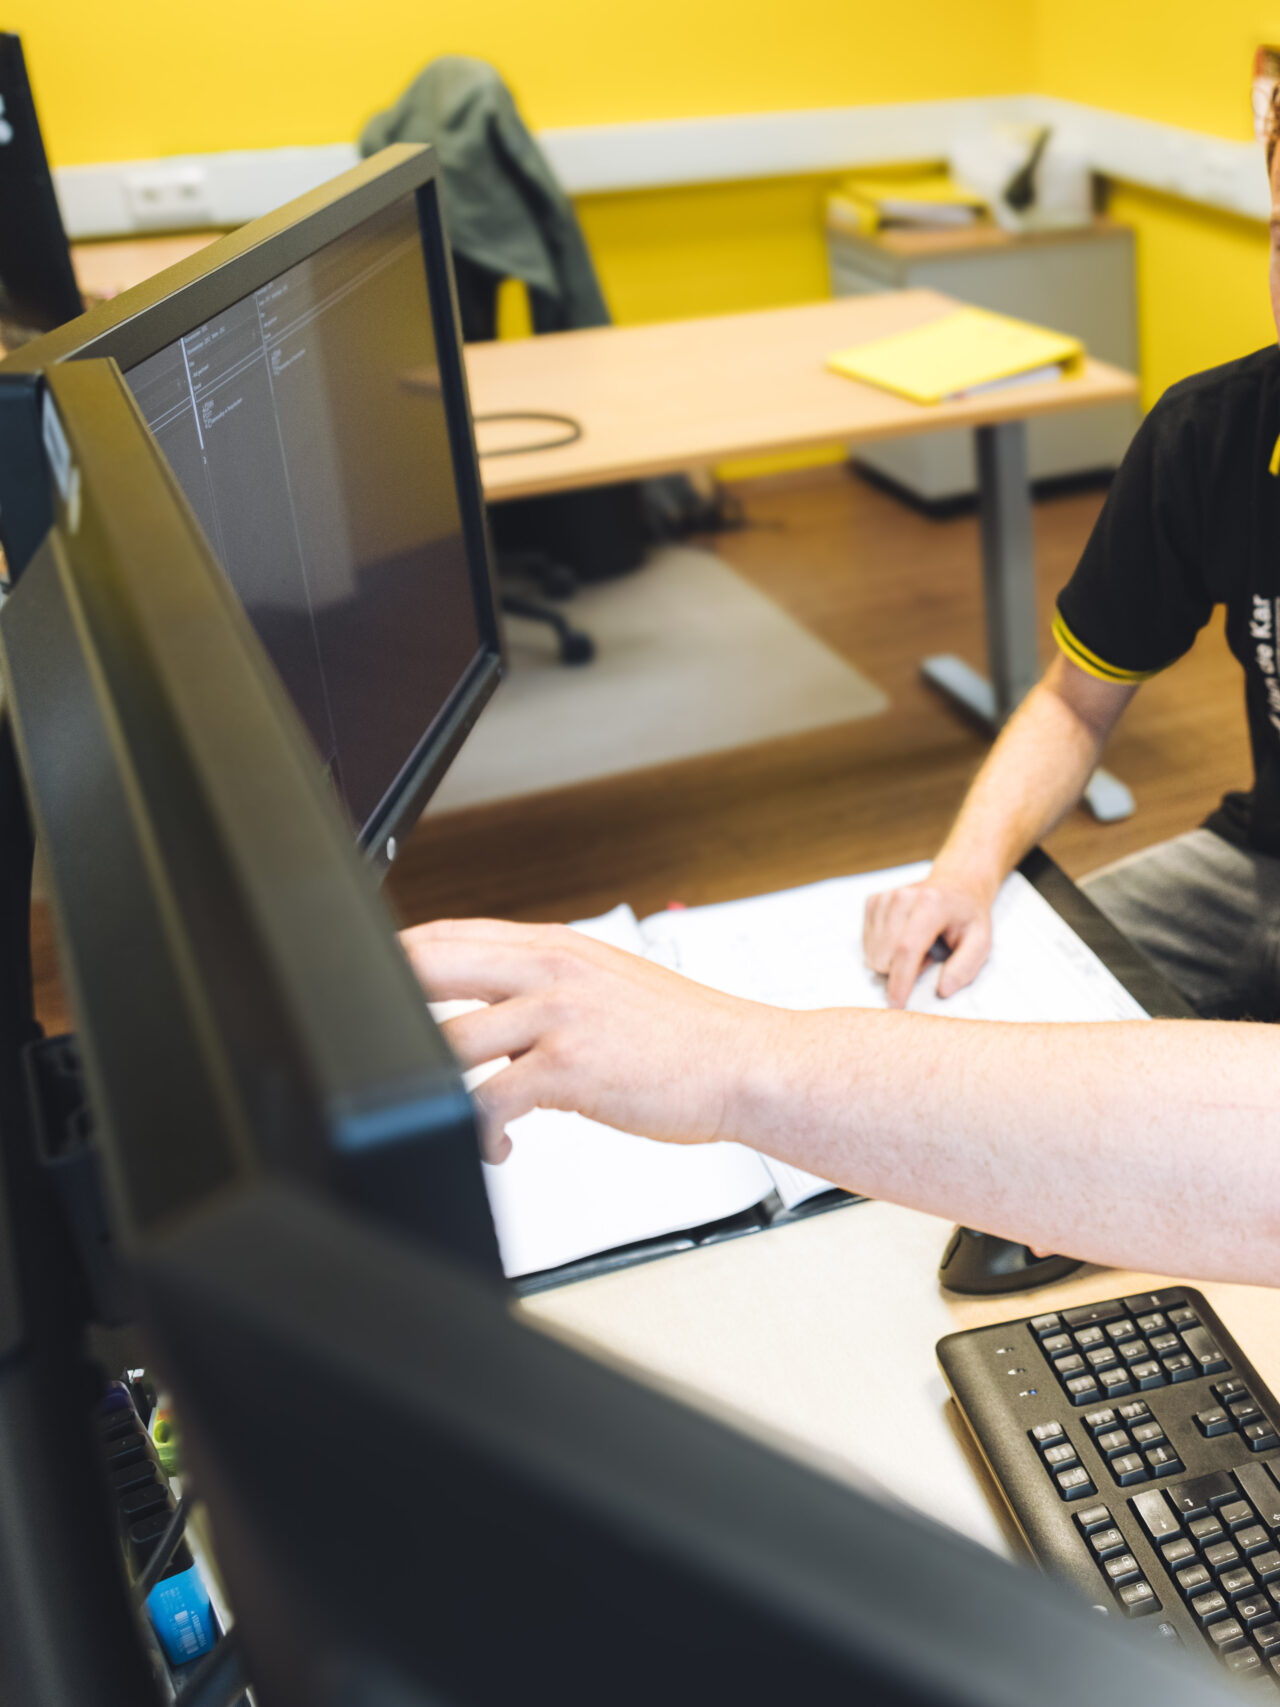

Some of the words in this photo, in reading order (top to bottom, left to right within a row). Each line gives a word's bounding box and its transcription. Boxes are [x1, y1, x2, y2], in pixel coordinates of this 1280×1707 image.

[1249, 593, 1272, 639] Kar
[1256, 643, 1275, 675] de
[1228, 1580, 1240, 1589] P
[1244, 1605, 1257, 1615] O
